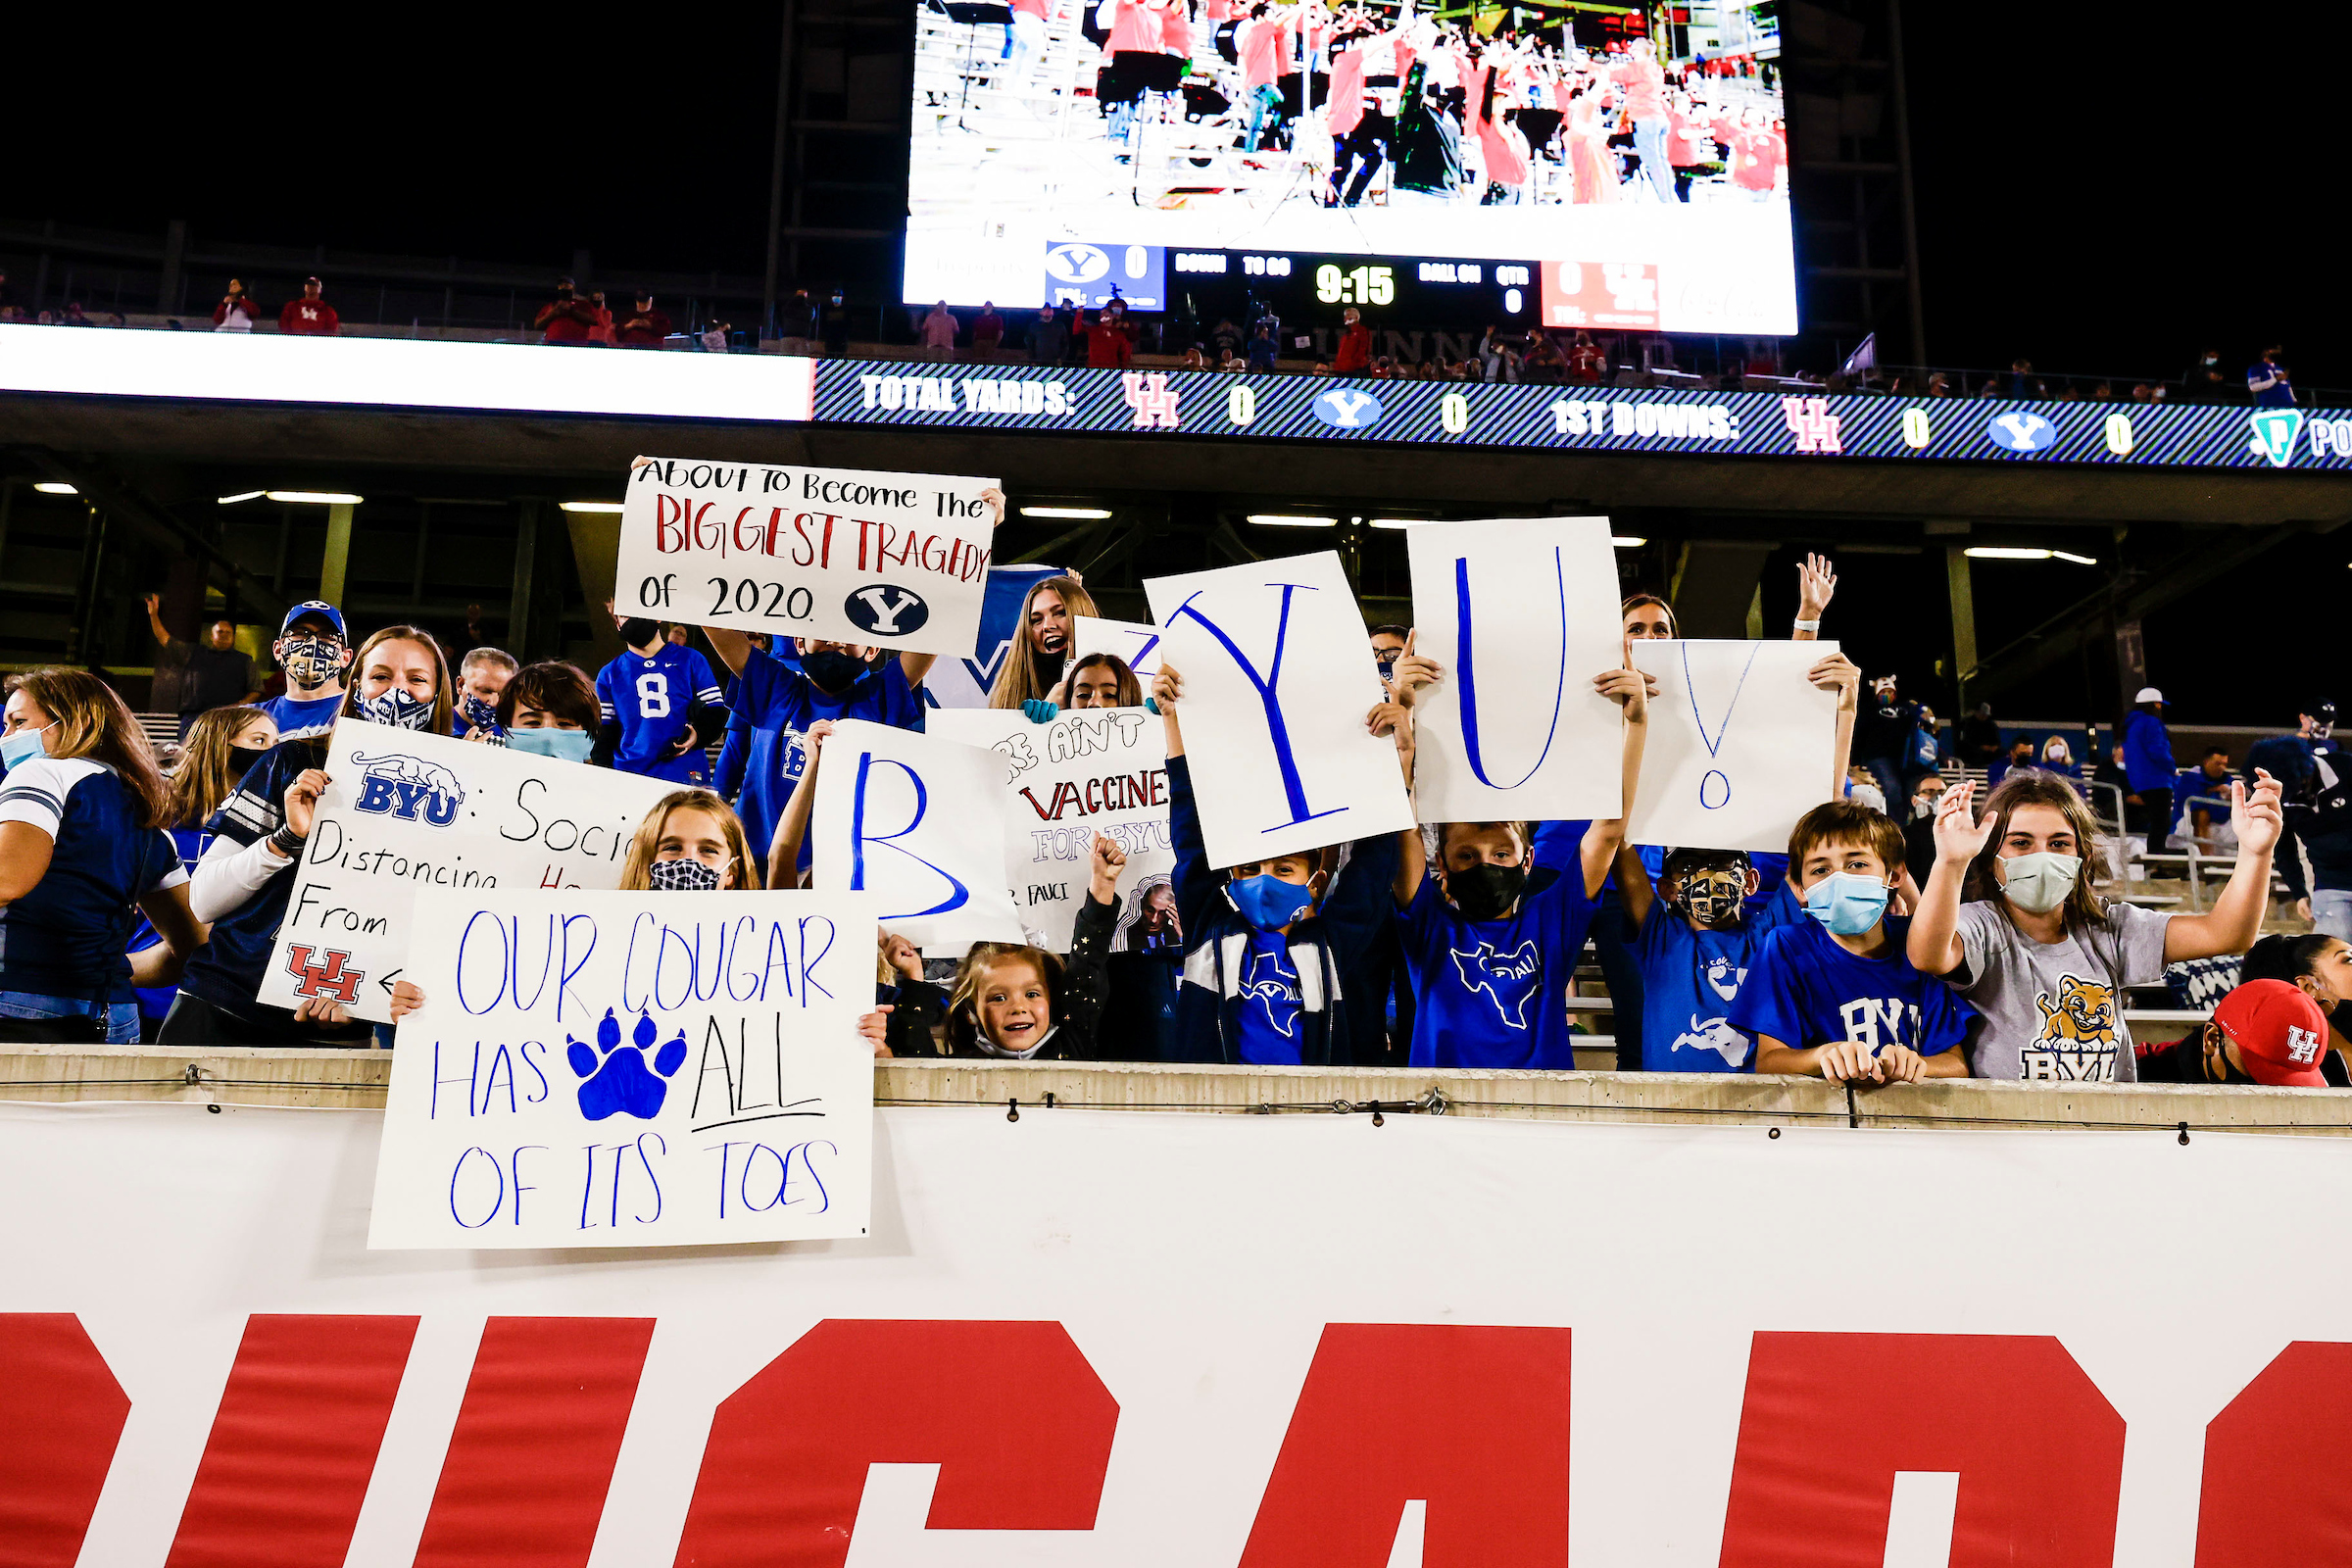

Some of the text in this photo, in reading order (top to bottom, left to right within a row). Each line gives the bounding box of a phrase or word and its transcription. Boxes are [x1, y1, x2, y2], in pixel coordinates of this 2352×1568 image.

[1125, 245, 1148, 279] 0
[1316, 264, 1395, 306] 9:15
[1495, 266, 1529, 285] QTR
[860, 373, 957, 412] TOTAL
[963, 378, 1076, 416] YARDS:
[1228, 385, 1254, 426] 0
[1321, 390, 1374, 427] Y
[1441, 393, 1468, 434] 0
[1550, 399, 1608, 435] 1ST
[1612, 401, 1740, 440] DOWNS:
[1902, 408, 1931, 449] 0
[1995, 414, 2048, 450] Y
[2105, 414, 2134, 455] 0
[657, 493, 993, 583] BIGGEST TRAGEDY
[707, 576, 814, 622] 2020.
[856, 587, 920, 633] Y
[1455, 545, 1567, 790] U
[636, 672, 671, 719] 8
[1164, 582, 1349, 834] Y
[1018, 769, 1169, 821] VACCINE
[850, 751, 969, 920] B
[1031, 818, 1174, 863] FOR BYU
[292, 882, 388, 936] From
[1028, 882, 1069, 906] FAUCI
[456, 910, 836, 1023] OUR COUGAR
[430, 1011, 823, 1120] HAS ALL
[2287, 1025, 2319, 1064] UH
[450, 1132, 838, 1231] OF ITS TOES
